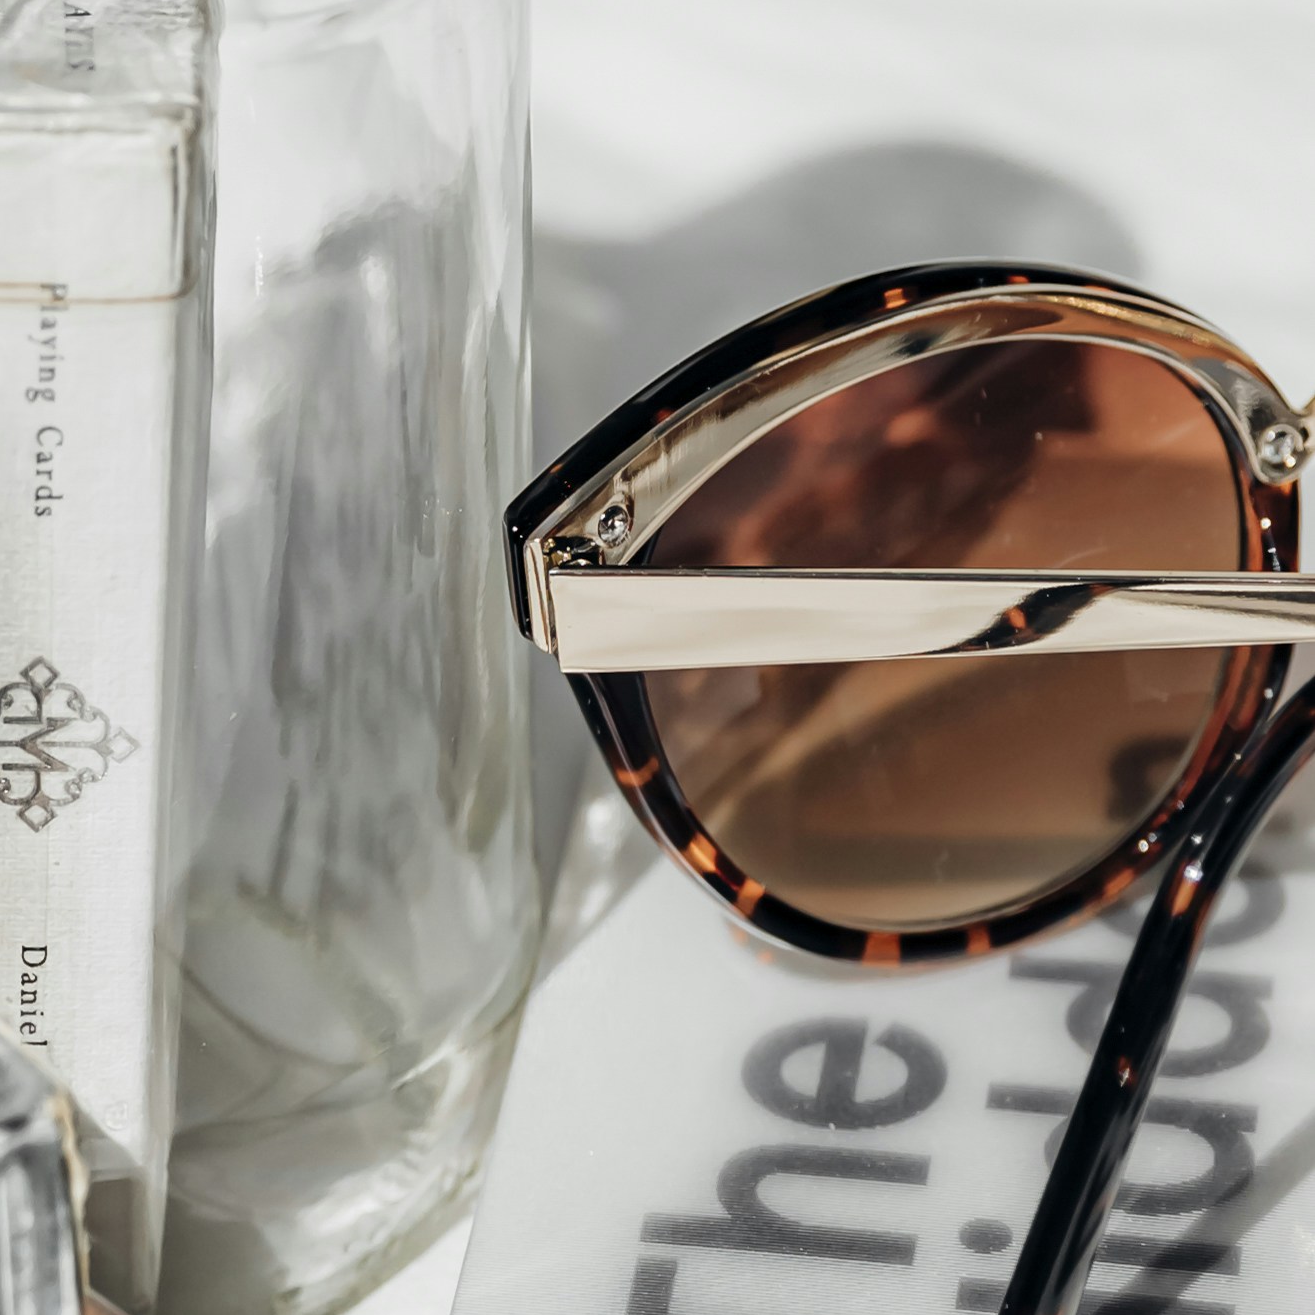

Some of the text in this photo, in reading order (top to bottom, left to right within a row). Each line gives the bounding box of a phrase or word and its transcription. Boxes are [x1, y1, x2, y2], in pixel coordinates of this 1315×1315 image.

[25, 283, 70, 518] Playing Cards
[19, 944, 49, 1047] Daniel
